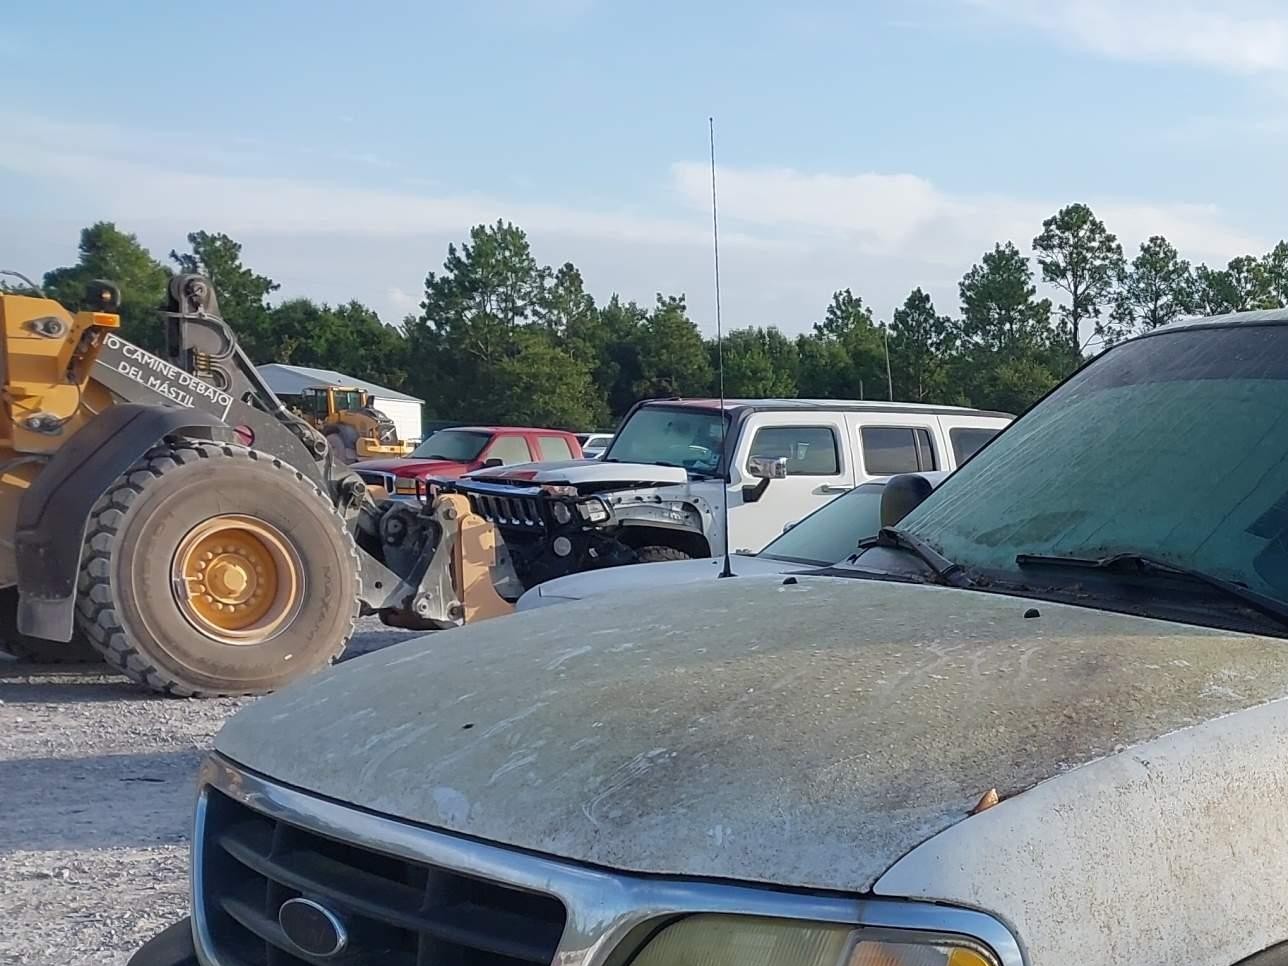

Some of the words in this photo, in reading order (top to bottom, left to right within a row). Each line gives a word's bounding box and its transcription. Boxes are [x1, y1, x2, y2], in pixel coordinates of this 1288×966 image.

[118, 361, 145, 383] DEL
[148, 376, 195, 408] MÁSTIL
[123, 345, 177, 379] CAMINE
[178, 374, 229, 407] DEBAJO
